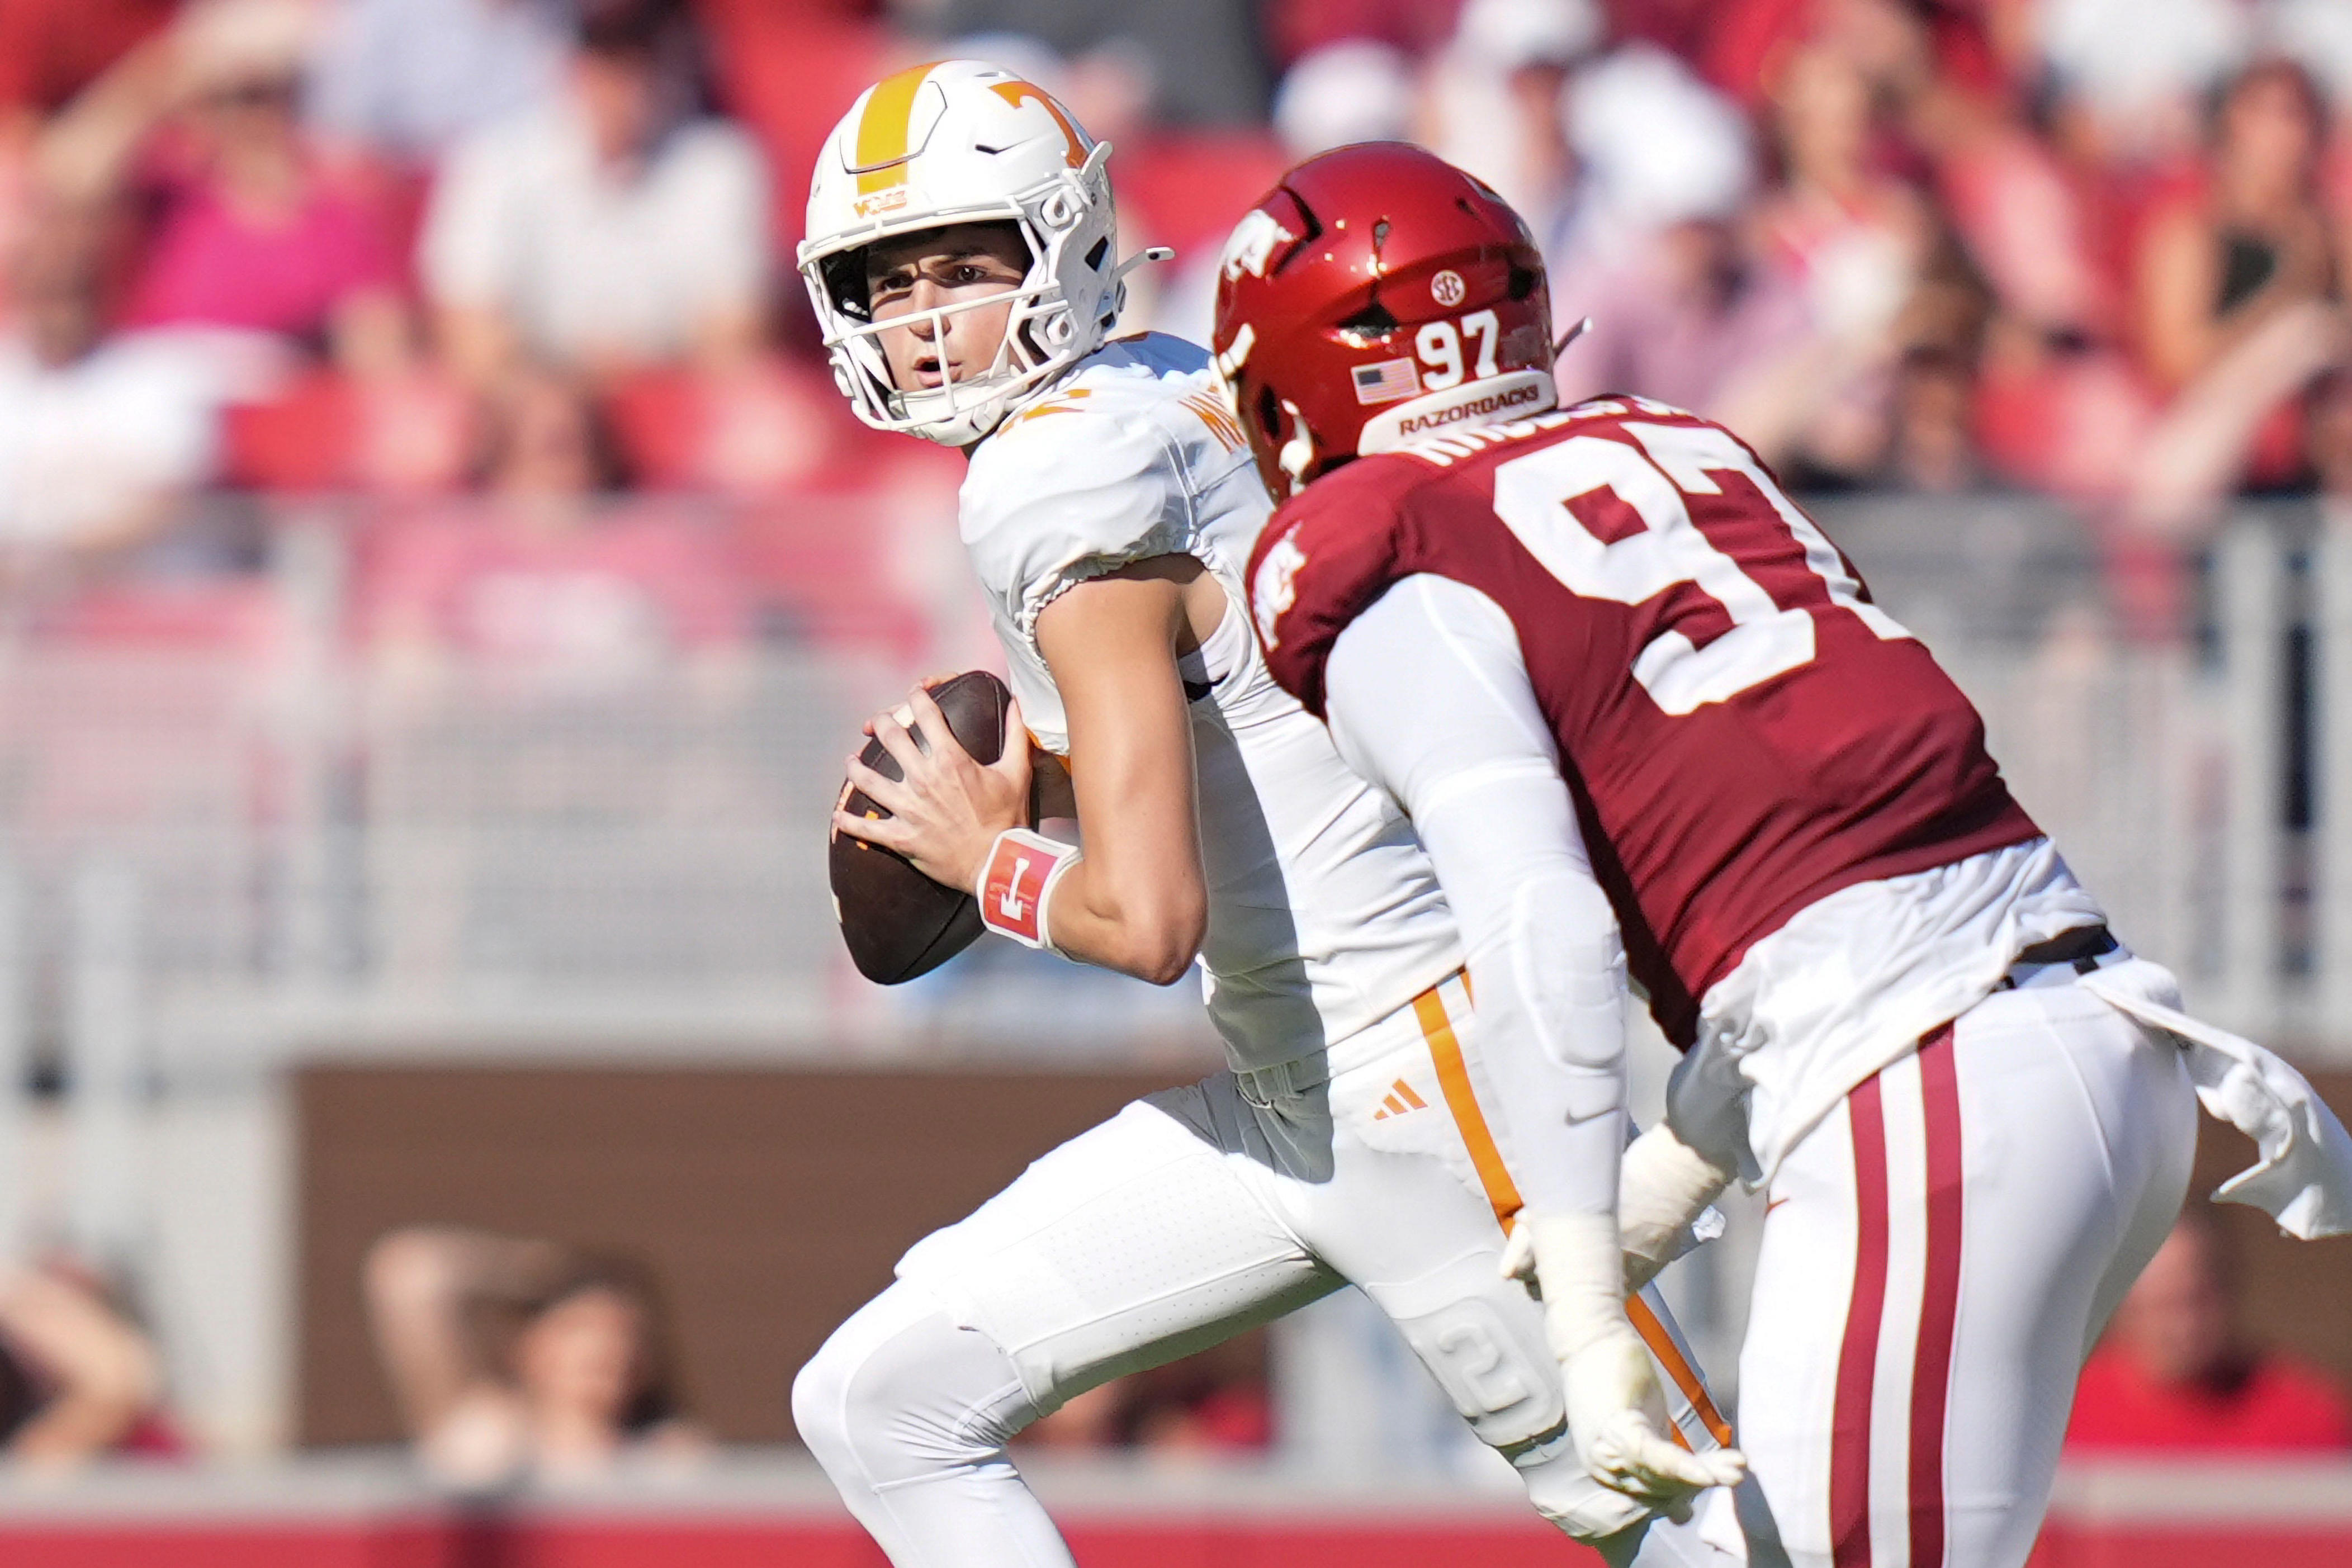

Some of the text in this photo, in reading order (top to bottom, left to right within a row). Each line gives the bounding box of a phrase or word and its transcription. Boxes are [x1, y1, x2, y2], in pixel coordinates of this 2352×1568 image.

[1415, 310, 1500, 391] 97
[1399, 384, 1539, 435] RAZORBACKS
[1493, 422, 1914, 716] 97
